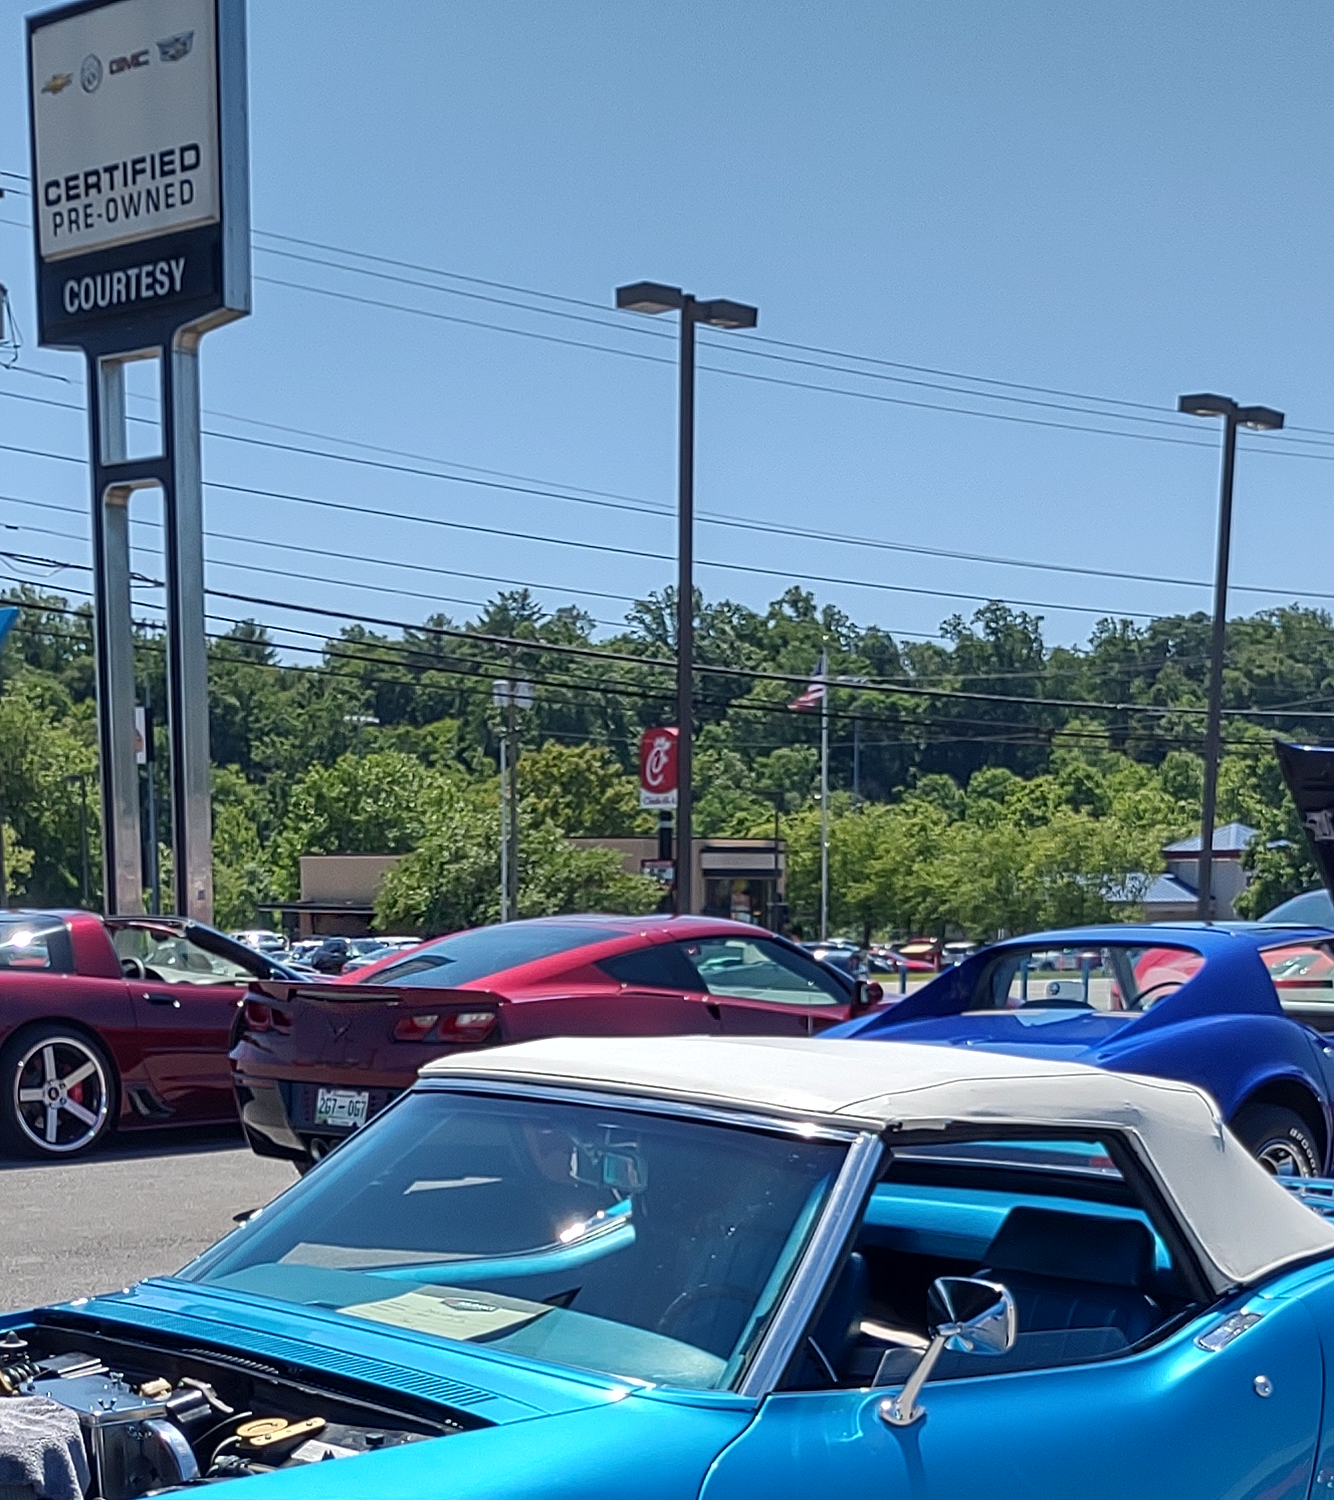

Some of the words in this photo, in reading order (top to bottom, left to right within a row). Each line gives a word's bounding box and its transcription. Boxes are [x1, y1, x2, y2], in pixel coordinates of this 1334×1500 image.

[44, 143, 201, 207] CERTIFIED
[52, 179, 195, 237] PRE-OWNED
[64, 257, 186, 313] COURTESY
